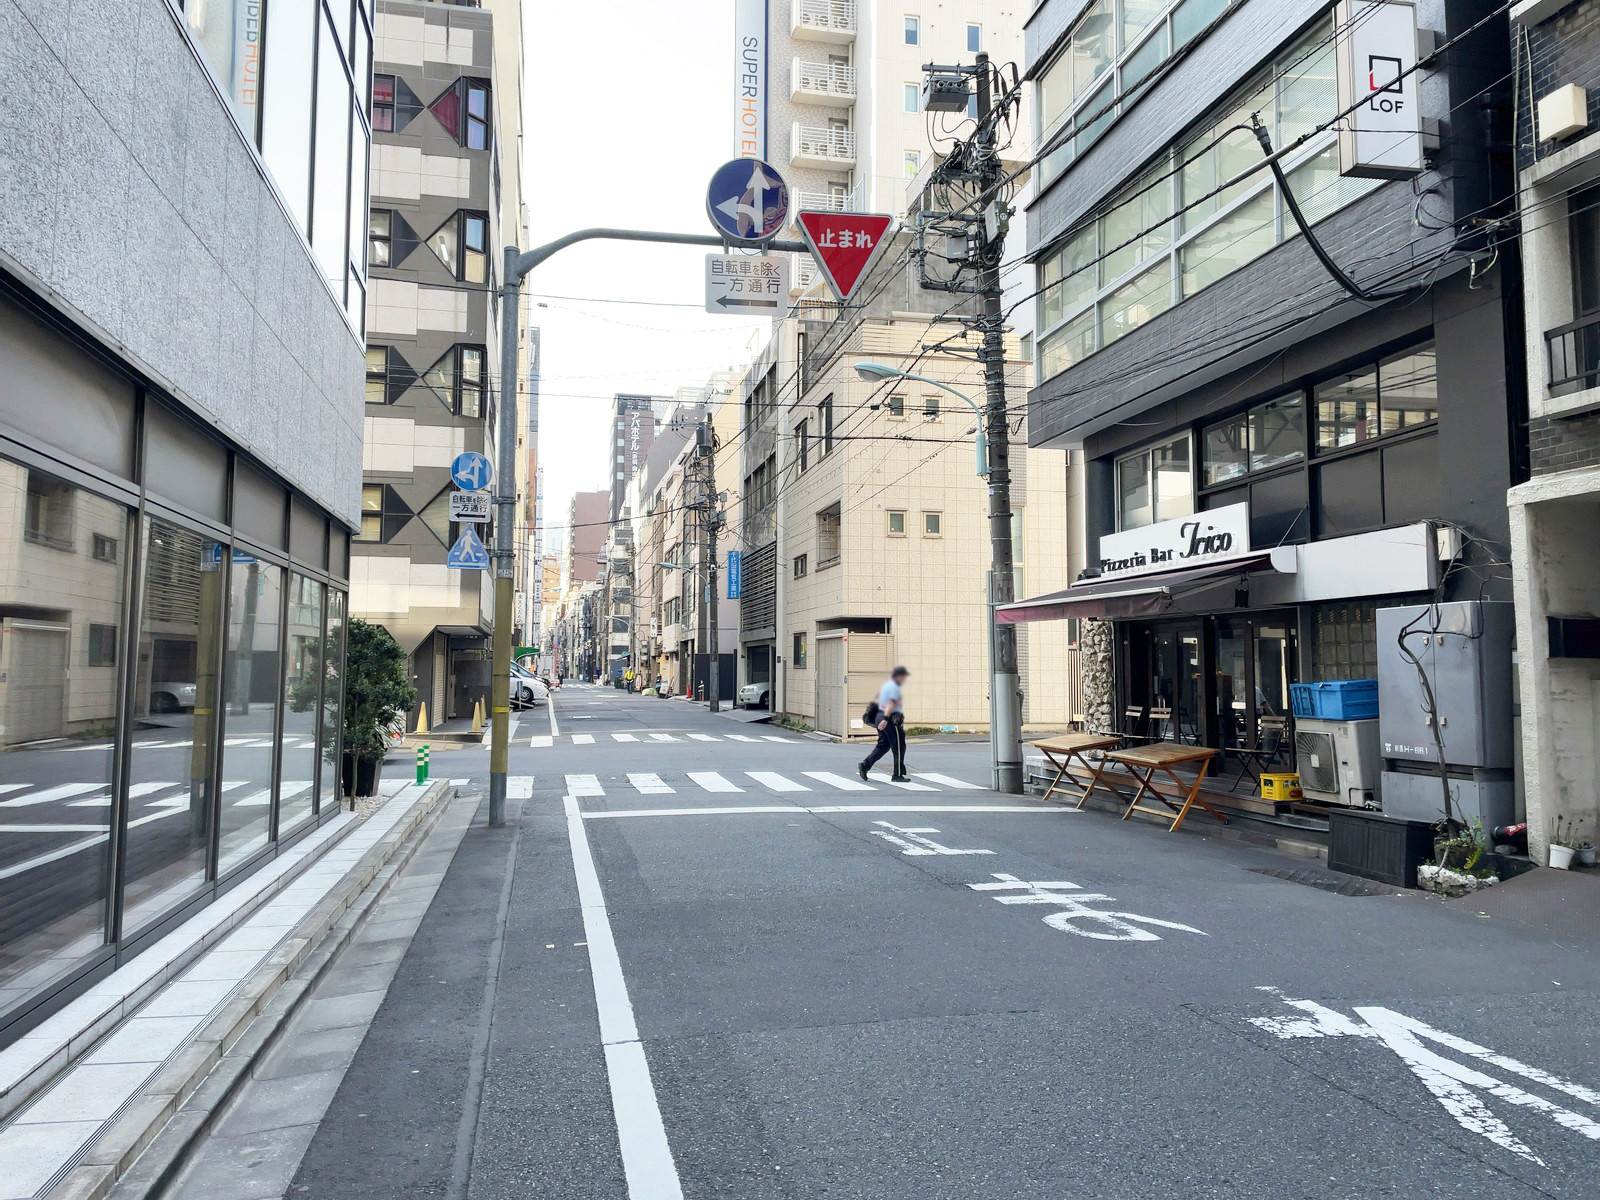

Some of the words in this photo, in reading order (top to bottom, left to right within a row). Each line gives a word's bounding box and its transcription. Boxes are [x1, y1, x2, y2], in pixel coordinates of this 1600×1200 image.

[1370, 97, 1404, 113] LOF
[817, 228, 874, 249] 止まれ
[711, 259, 781, 277] 自転車を除く
[711, 277, 781, 294] 一方通行
[452, 494, 488, 504] 自転車を除く
[452, 504, 488, 513] 一方通行
[1101, 551, 1147, 573] Pizzeria
[1150, 547, 1174, 563] Bar
